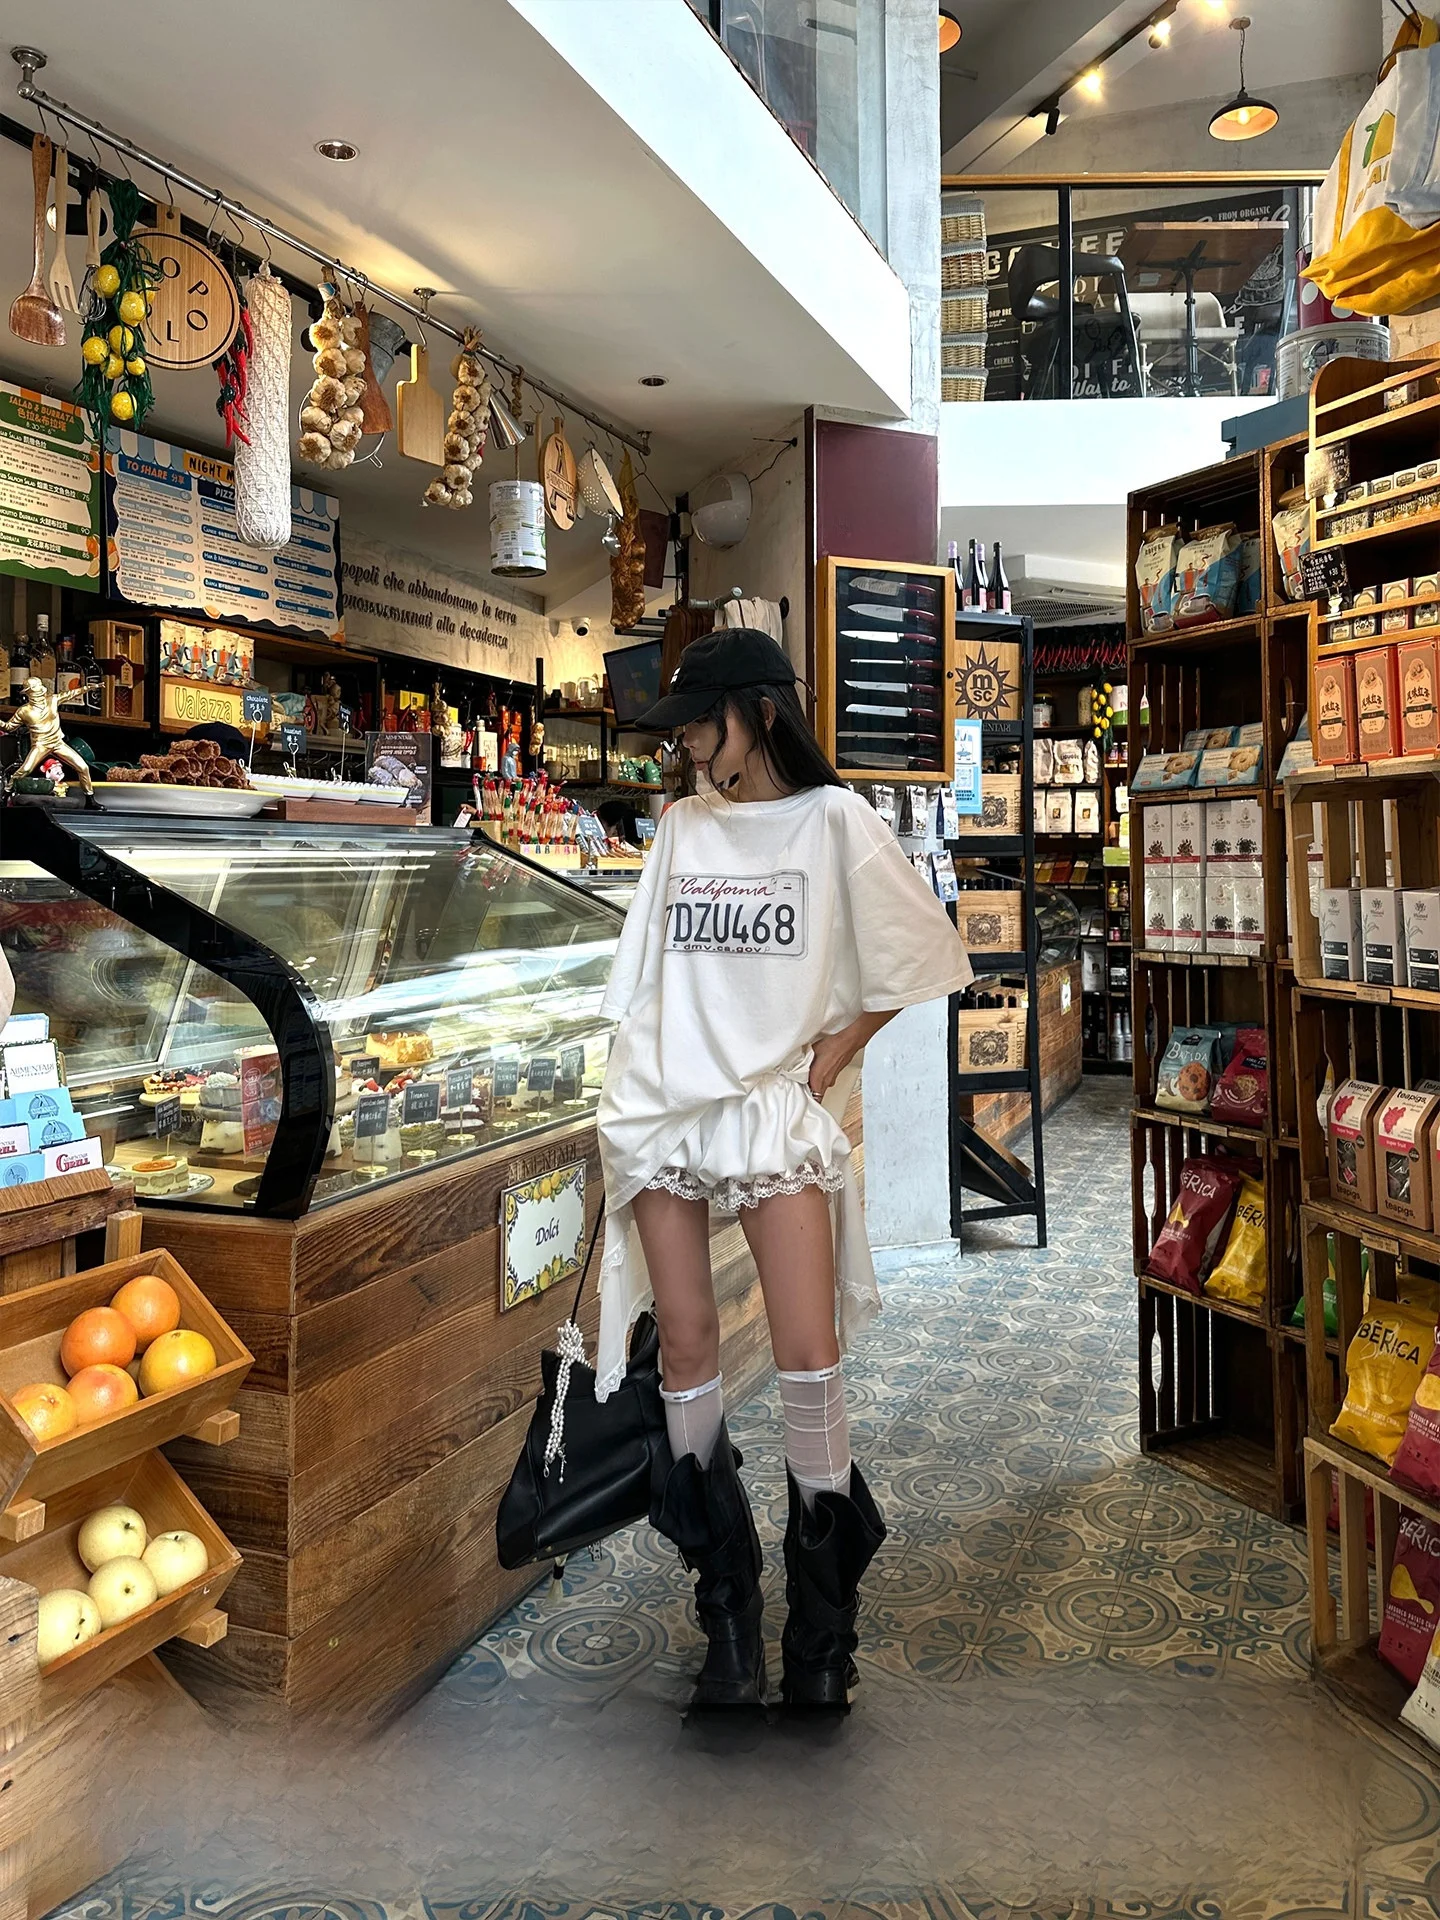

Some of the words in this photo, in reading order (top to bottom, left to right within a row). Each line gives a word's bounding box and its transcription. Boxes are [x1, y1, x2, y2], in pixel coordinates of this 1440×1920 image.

[1218, 210, 1238, 221] FROM
[1240, 205, 1271, 218] ORGANIC
[1112, 377, 1131, 392] to
[9, 396, 33, 411] SALAD
[41, 406, 75, 424] BURRATA
[126, 460, 139, 471] TO
[141, 464, 168, 480] SHARE
[189, 457, 222, 478] NIGHT
[215, 487, 235, 500] PIZZ
[342, 560, 380, 586] popoli
[383, 571, 405, 593] che
[408, 579, 479, 614] abbandonano
[482, 600, 491, 617] la
[495, 606, 517, 626] terra
[436, 615, 455, 634] alla
[459, 621, 509, 649] decadenza
[175, 686, 233, 724] Valazza
[680, 877, 776, 902] California
[683, 944, 763, 954] dmv.ca.gov
[1166, 1042, 1209, 1063] BATIDA
[1424, 1082, 1440, 1091] teap
[535, 1217, 560, 1246] Dolci
